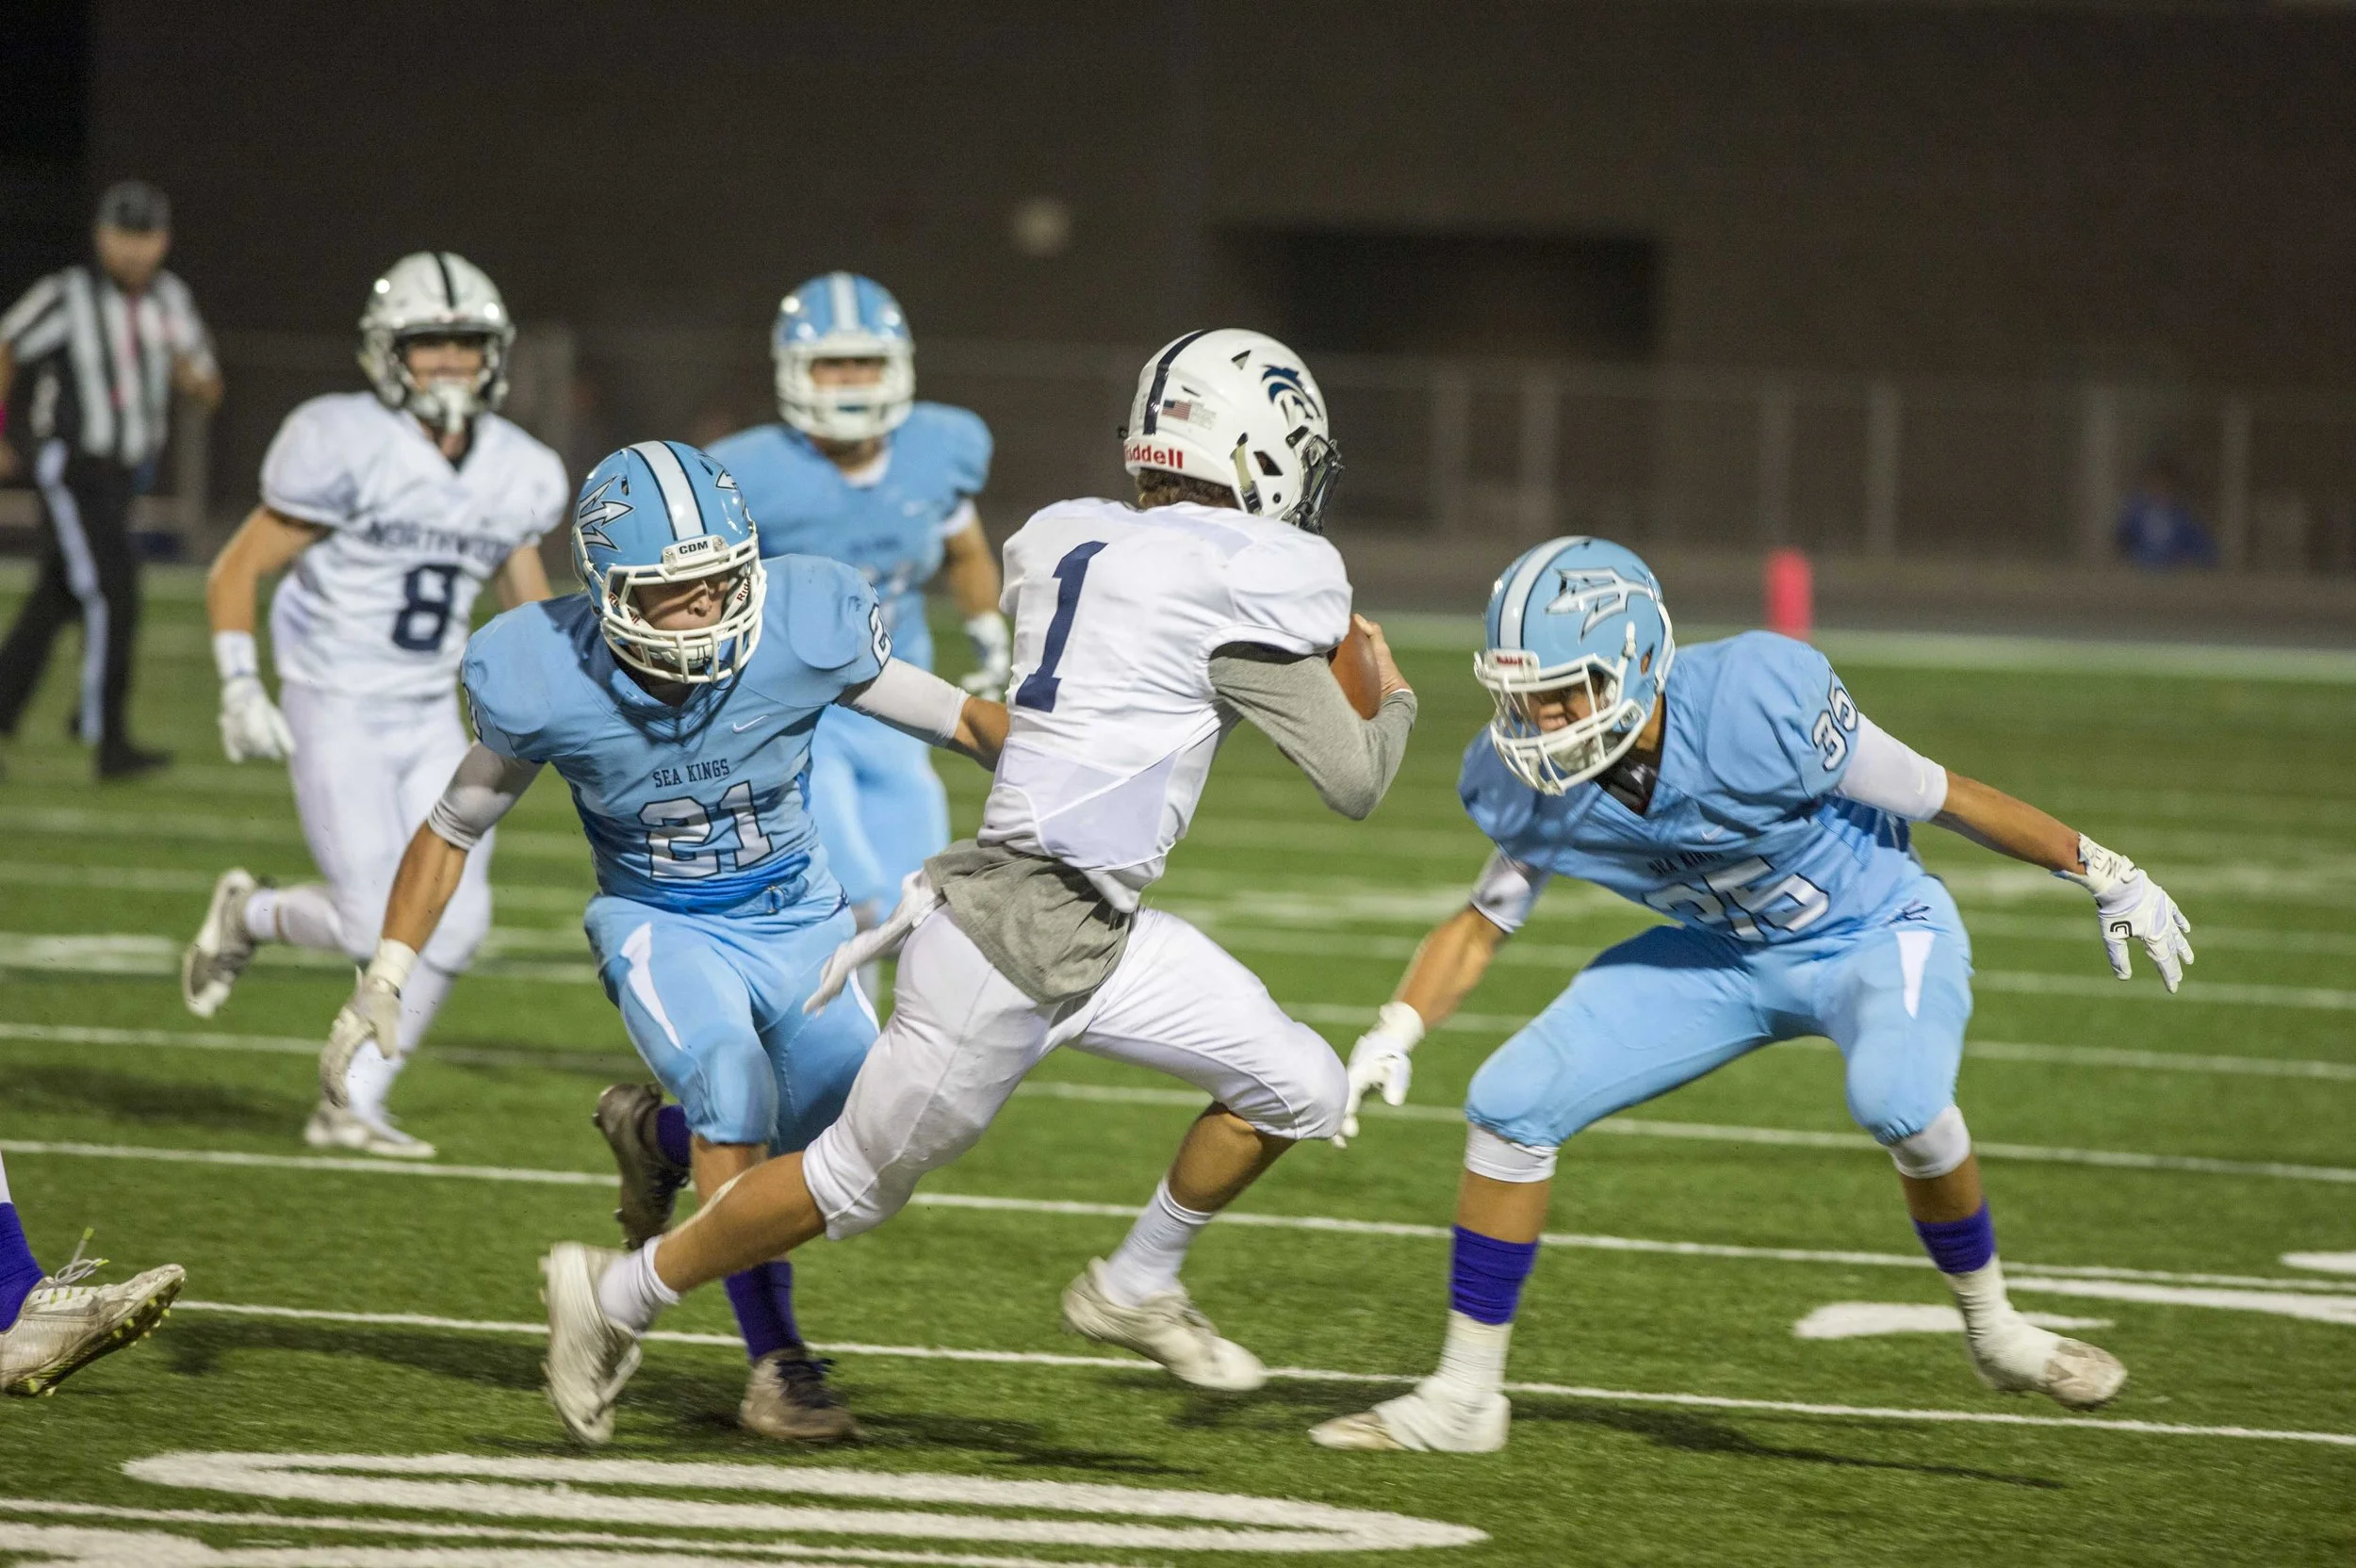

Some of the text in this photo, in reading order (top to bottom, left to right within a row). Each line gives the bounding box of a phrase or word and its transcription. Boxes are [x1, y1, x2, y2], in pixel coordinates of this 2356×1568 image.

[679, 540, 709, 555] CDM
[391, 563, 461, 652] 8
[1015, 540, 1109, 713] 1
[1811, 666, 1858, 772] 35
[652, 758, 730, 789] SEA KINGS
[637, 779, 774, 880] 21
[1640, 854, 1831, 943] 35
